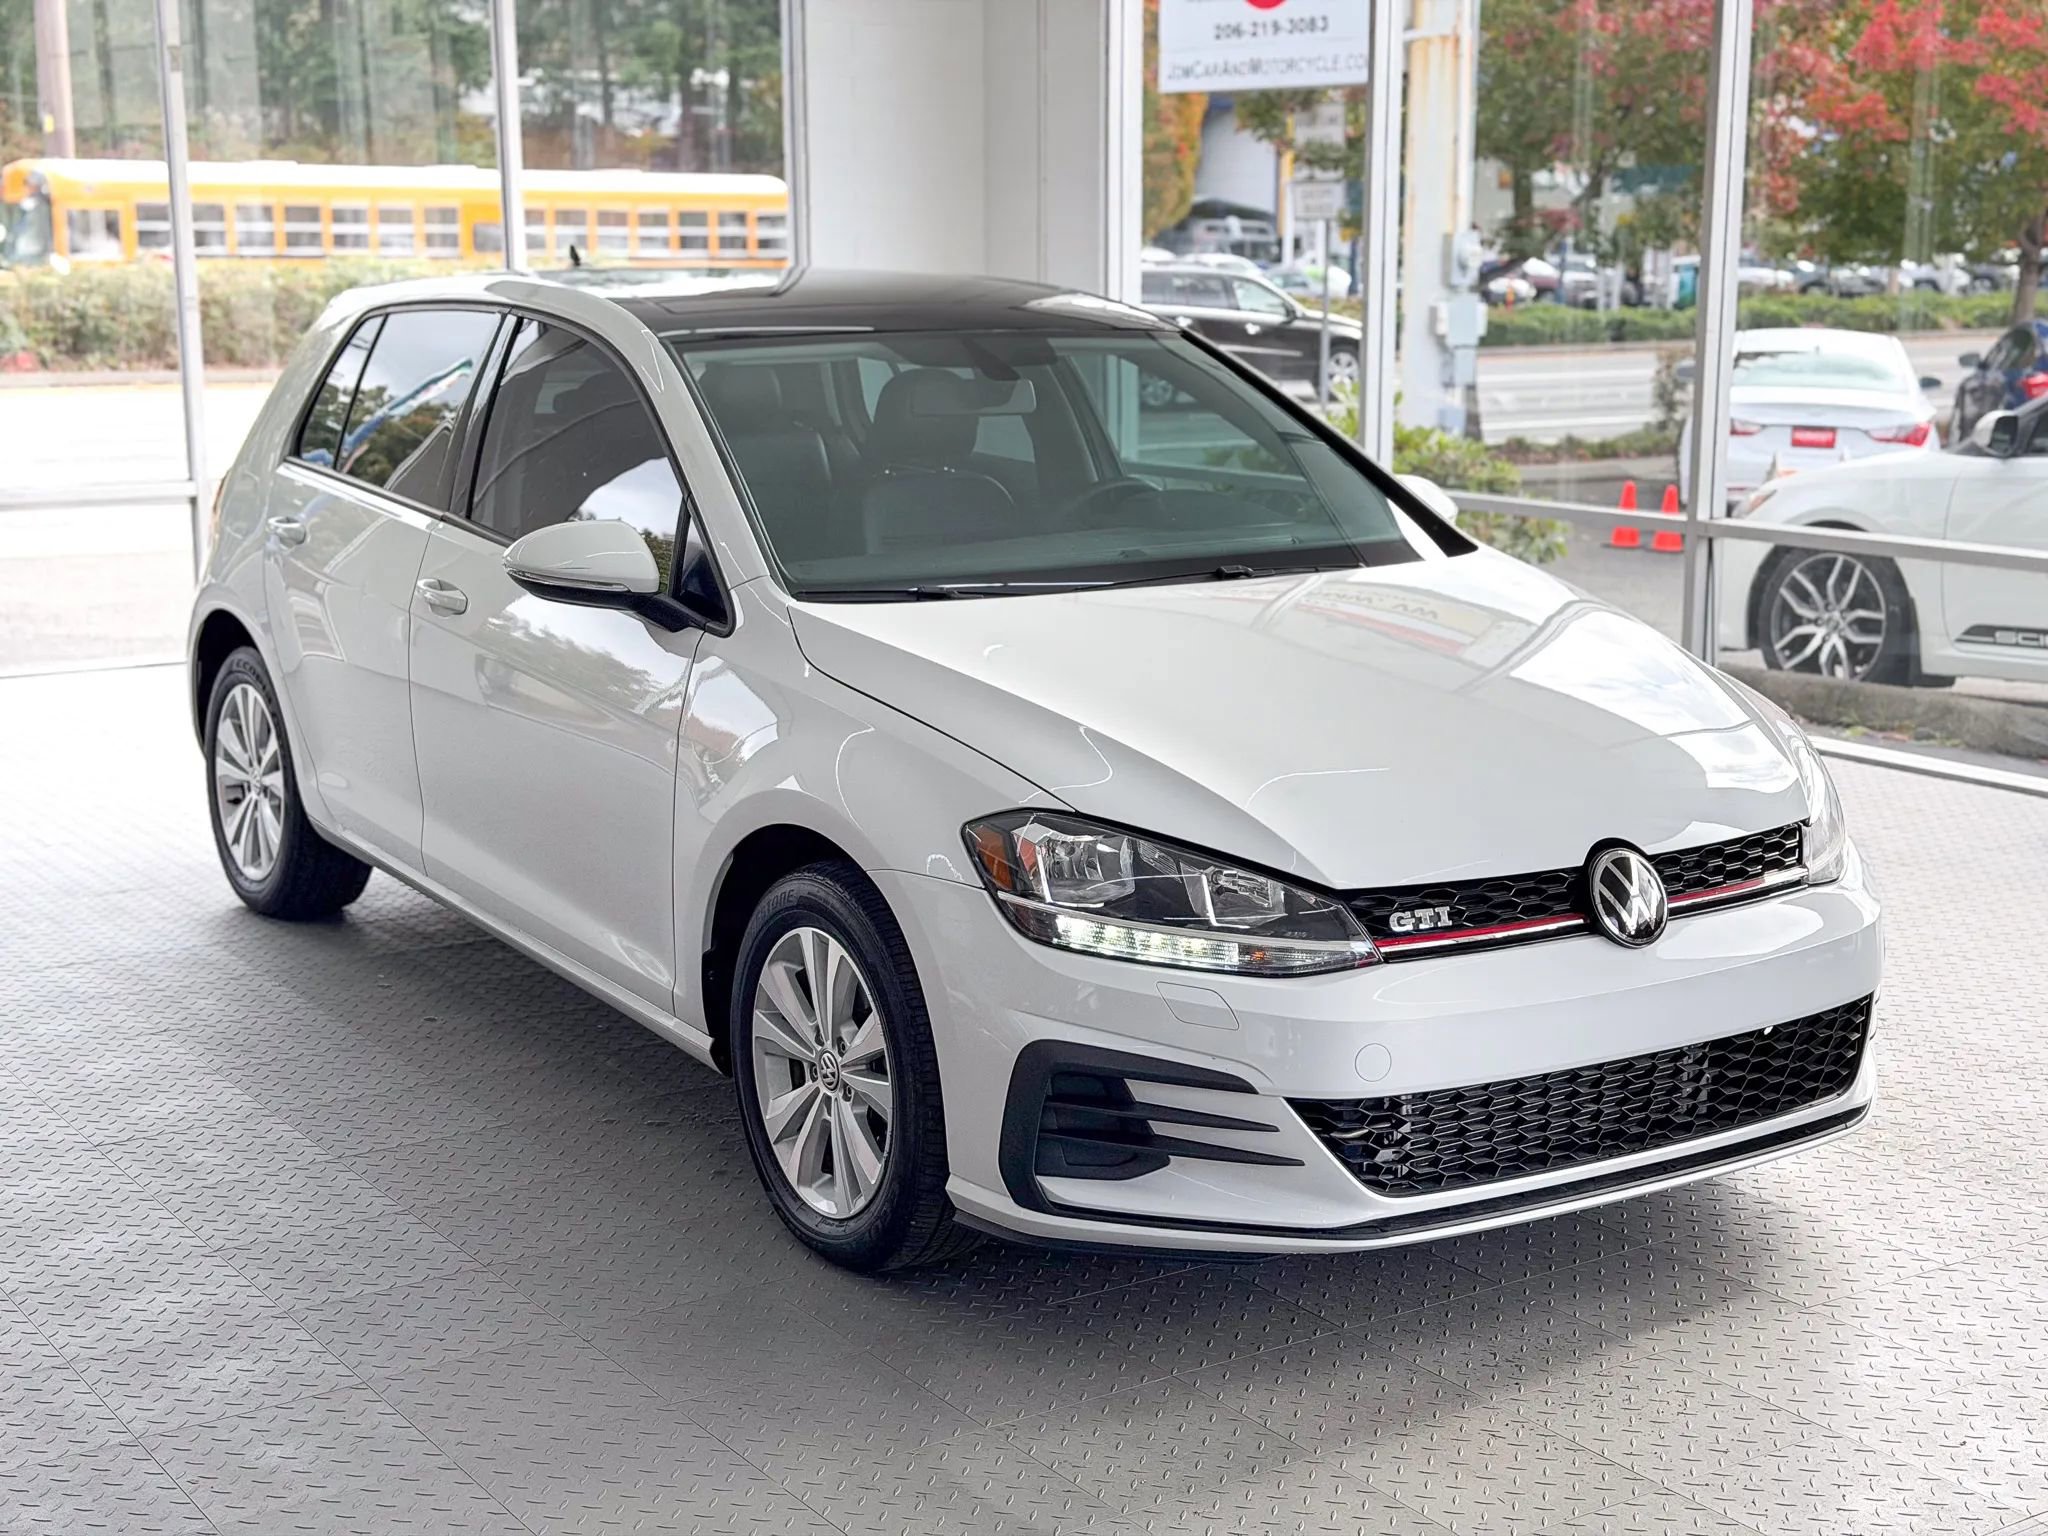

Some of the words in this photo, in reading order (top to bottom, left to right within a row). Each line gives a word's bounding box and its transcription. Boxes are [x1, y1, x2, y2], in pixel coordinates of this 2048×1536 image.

[1213, 14, 1329, 40] 206-219-3083
[1995, 630, 2048, 647] SCI
[1388, 905, 1453, 933] GTI
